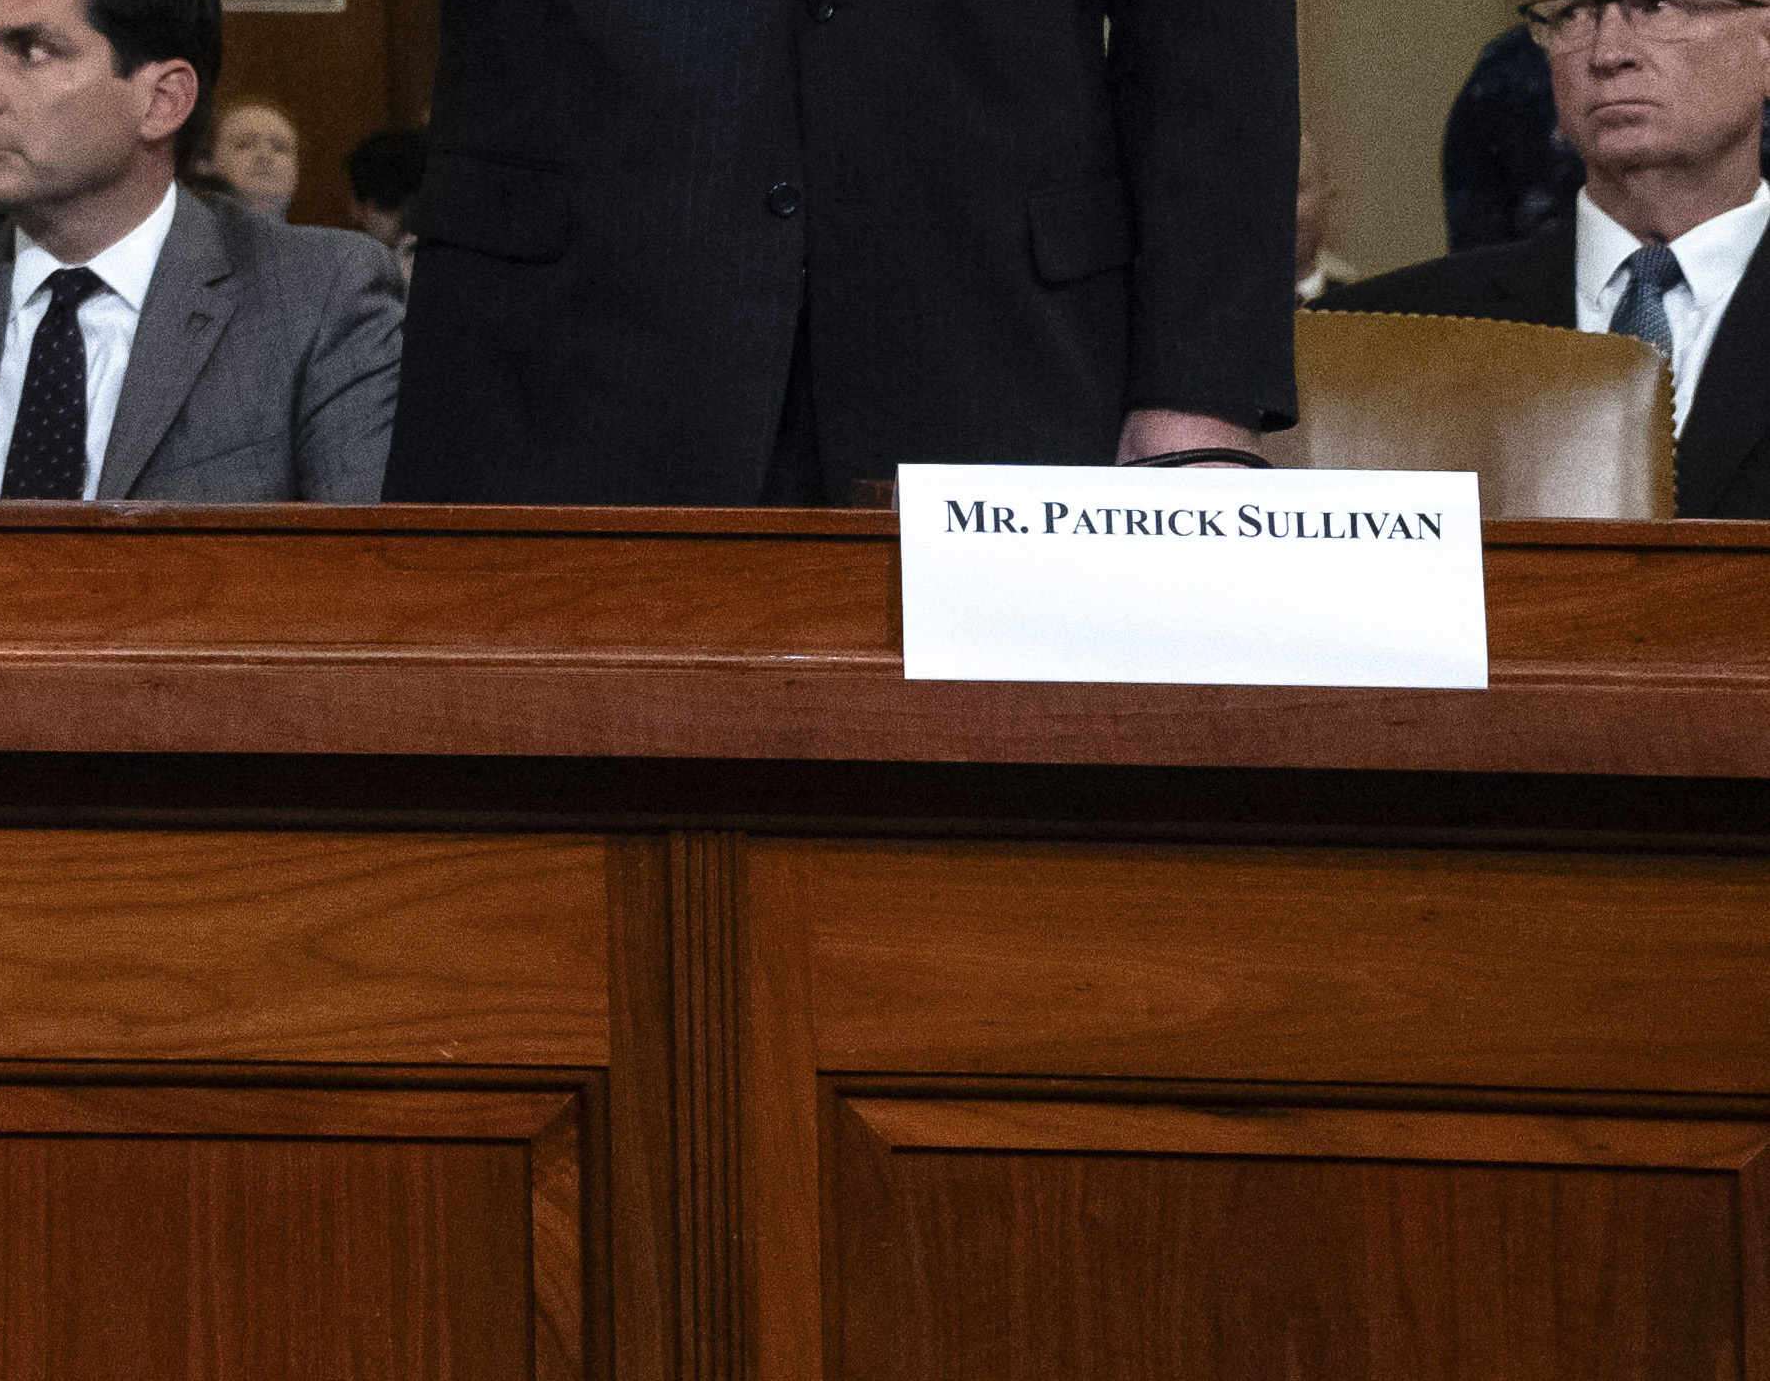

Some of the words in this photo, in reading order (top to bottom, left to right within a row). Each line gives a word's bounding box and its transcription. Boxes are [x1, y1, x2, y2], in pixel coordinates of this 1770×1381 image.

[943, 499, 1030, 536] MR.
[1041, 500, 1227, 538] PATRICK
[1236, 503, 1444, 541] SULLIVAN
